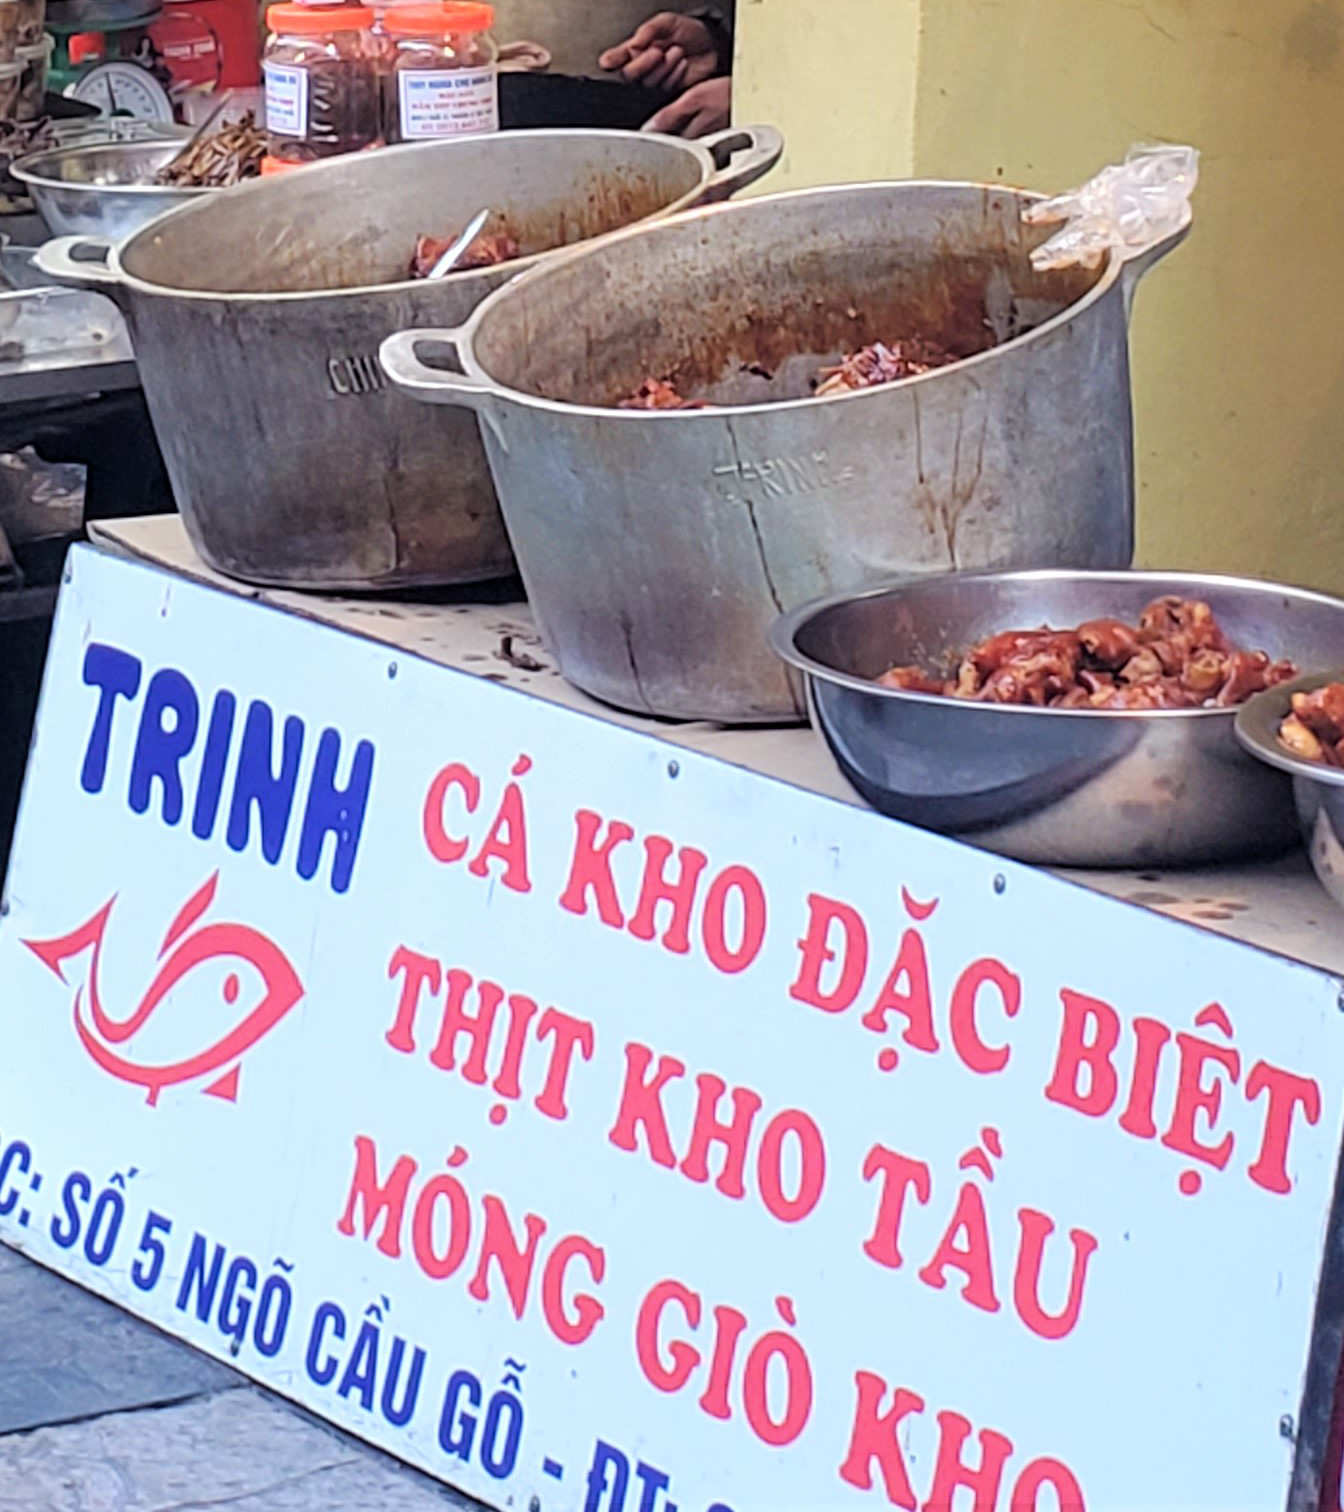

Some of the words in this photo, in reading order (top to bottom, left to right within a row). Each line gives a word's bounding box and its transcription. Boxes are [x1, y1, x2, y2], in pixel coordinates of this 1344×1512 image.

[80, 642, 376, 894] TRINH
[422, 753, 534, 894] CÁ
[558, 809, 768, 974] KHO
[789, 885, 1021, 1075] ĐẶC
[1044, 988, 1321, 1196] BIỆT
[337, 1135, 606, 1345] MÓNG
[636, 1279, 813, 1447] GIÒ
[385, 945, 594, 1126] THỊT
[609, 1042, 826, 1224] KHO
[863, 1127, 1098, 1340] TẦU
[50, 1167, 138, 1267] SỐ
[131, 1210, 172, 1290] 5
[176, 1232, 295, 1357] NGÕ
[305, 1294, 427, 1427] CẦU
[438, 1358, 527, 1480] GỖ
